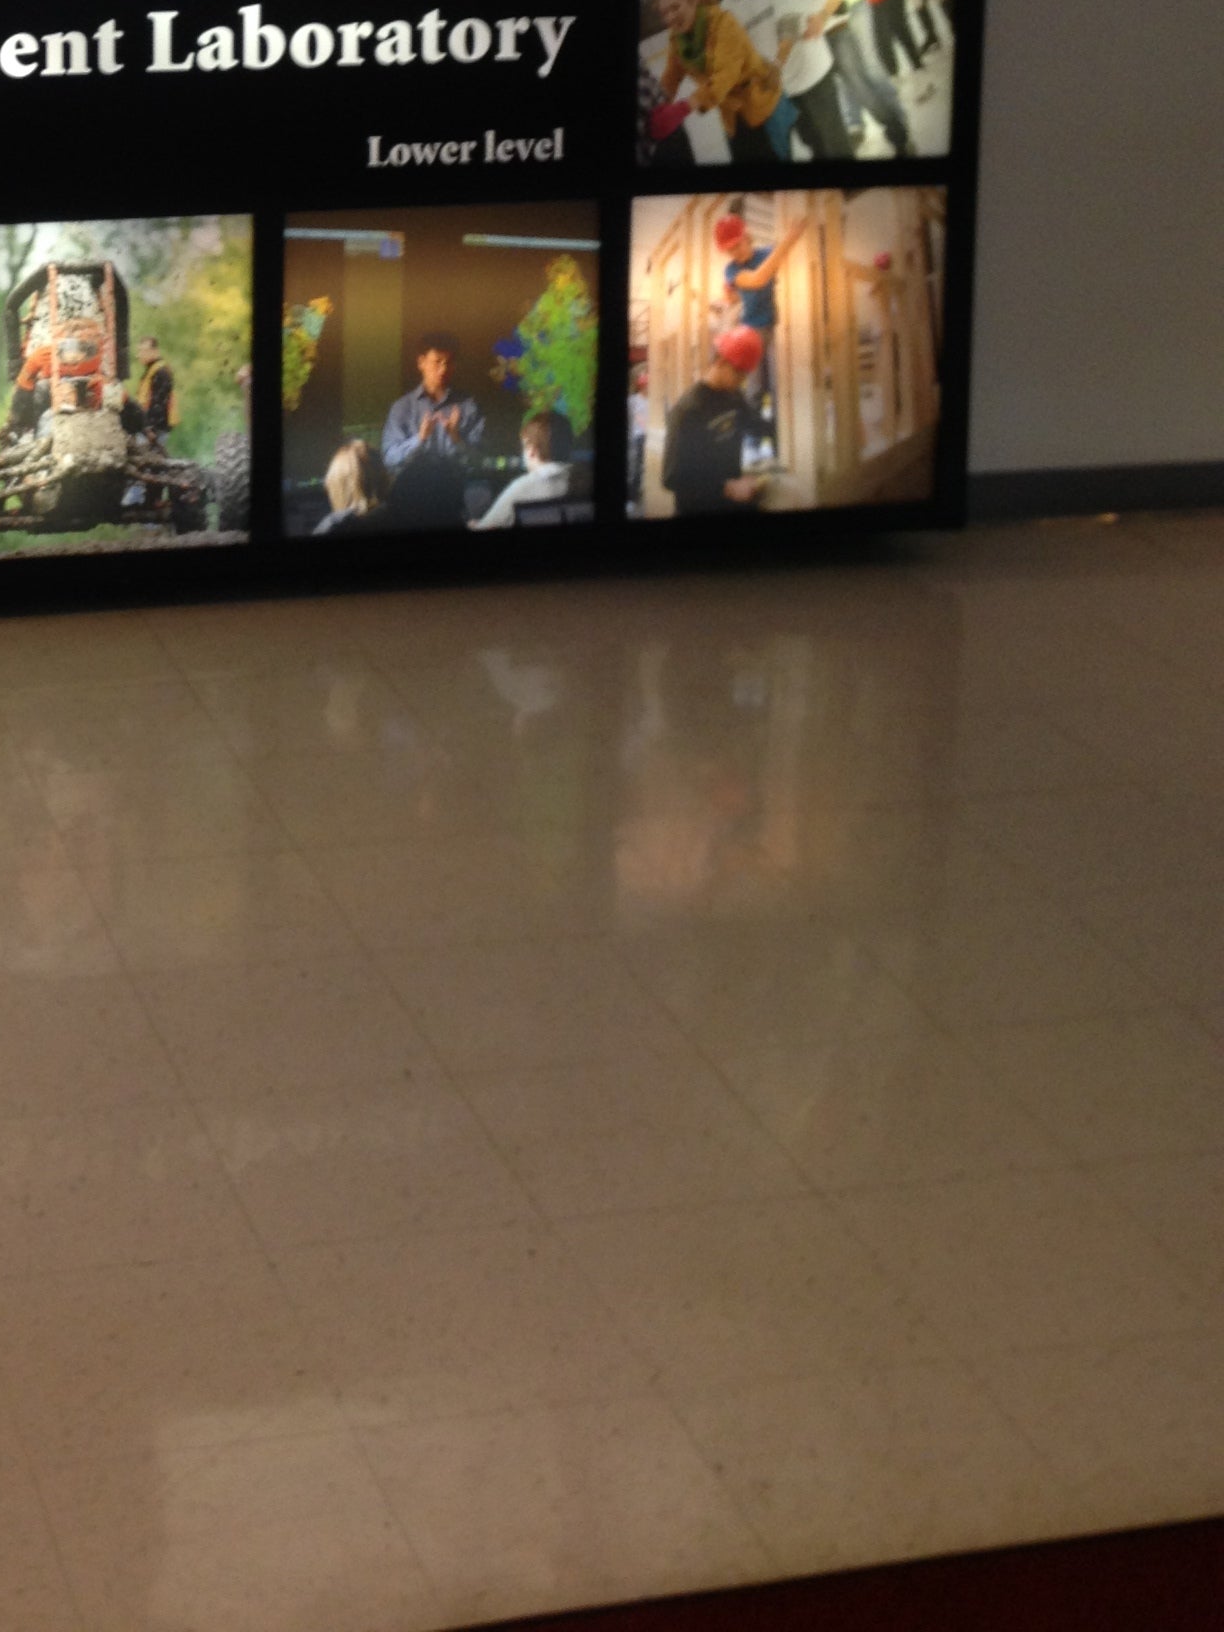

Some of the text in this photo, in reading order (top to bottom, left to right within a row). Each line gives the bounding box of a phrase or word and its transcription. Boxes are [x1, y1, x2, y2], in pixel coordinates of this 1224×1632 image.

[145, 2, 576, 78] Laboratory
[367, 127, 565, 168] Lower level
